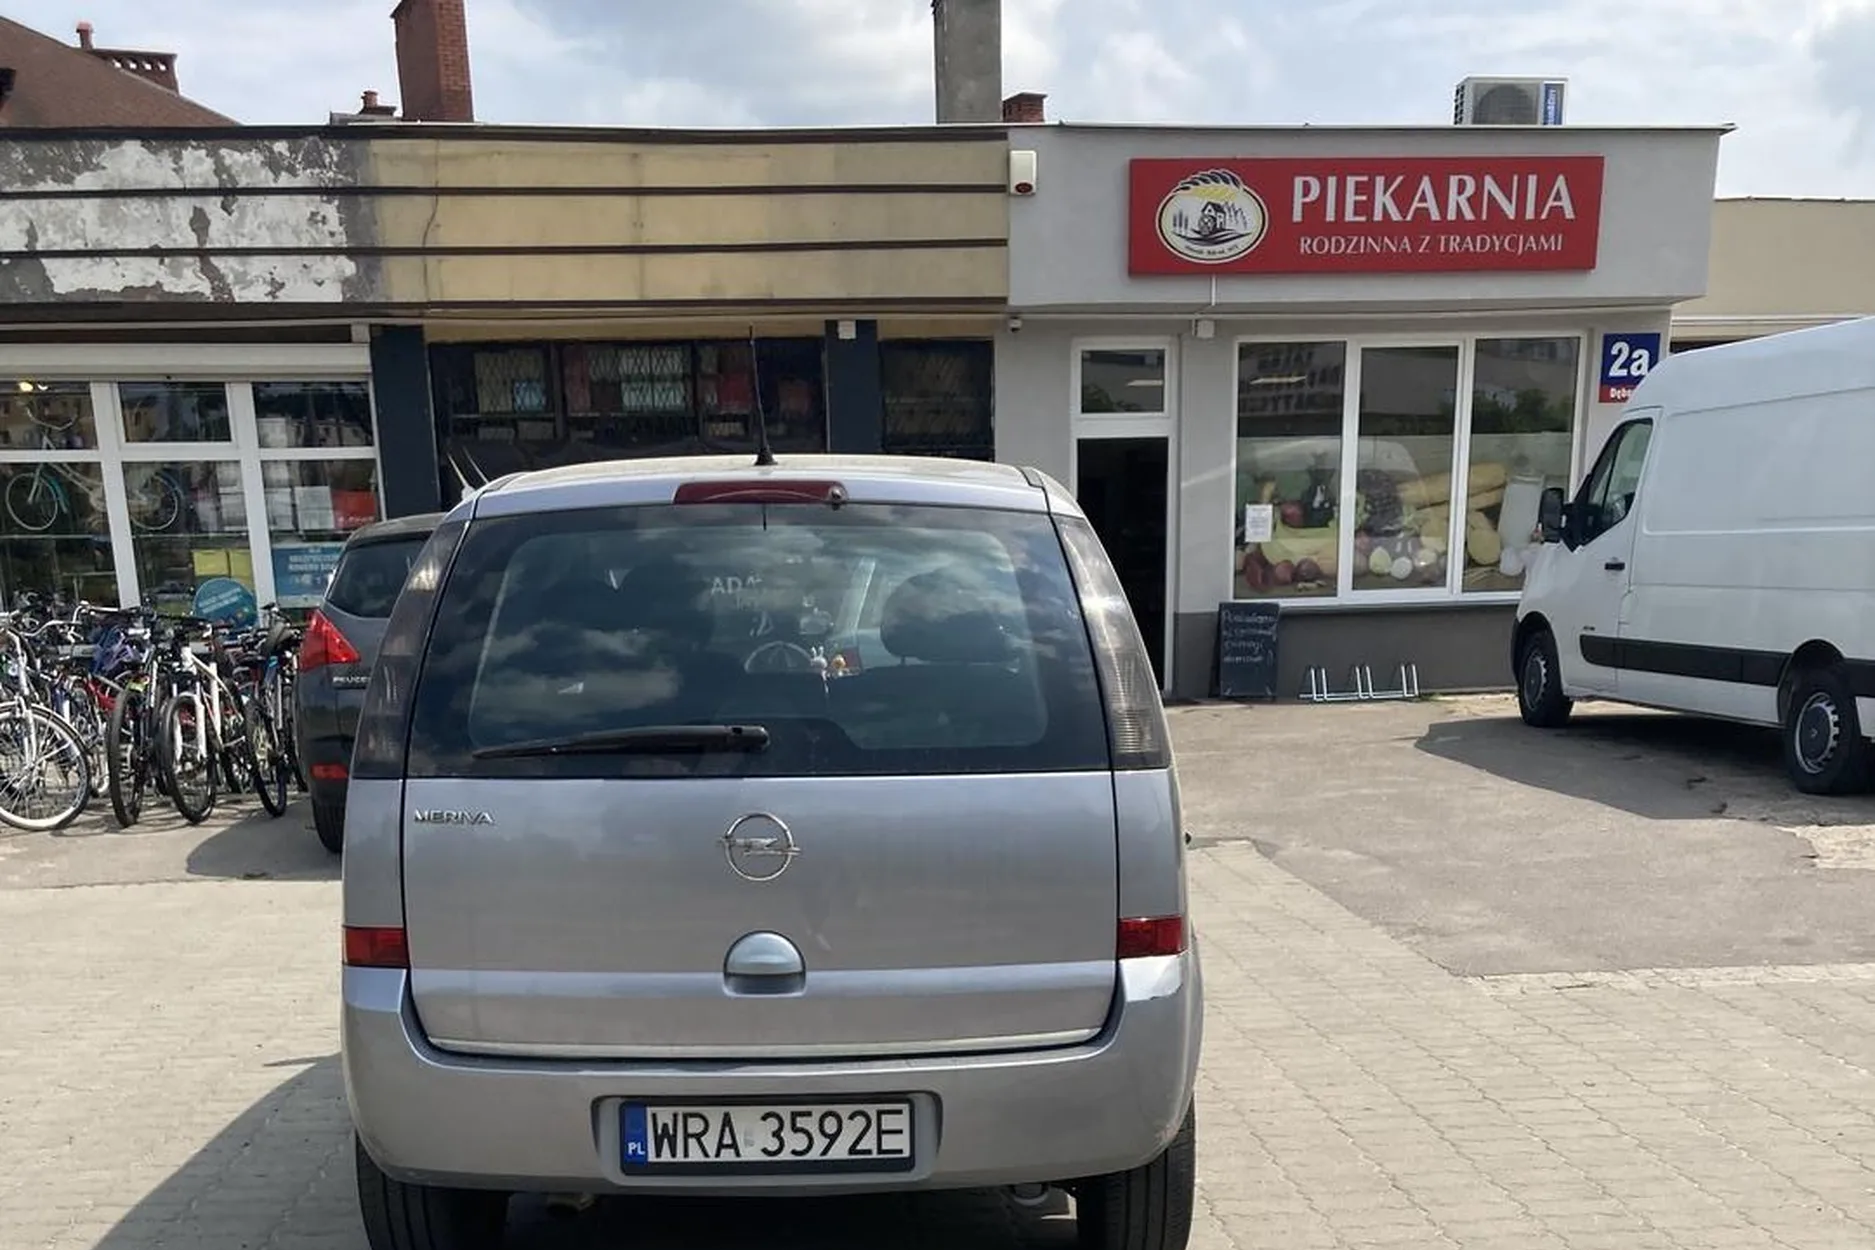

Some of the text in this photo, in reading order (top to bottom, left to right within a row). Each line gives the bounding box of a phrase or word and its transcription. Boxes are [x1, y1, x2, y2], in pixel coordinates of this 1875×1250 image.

[1291, 173, 1576, 223] PIEKARNIA
[1300, 233, 1563, 255] RODZINNA Z TRADYCJAMI
[1608, 341, 1650, 377] 2a
[333, 676, 371, 684] PEUGE
[414, 808, 495, 825] MERIVA
[651, 1108, 904, 1159] WRA 3592E
[627, 1142, 646, 1155] PL
